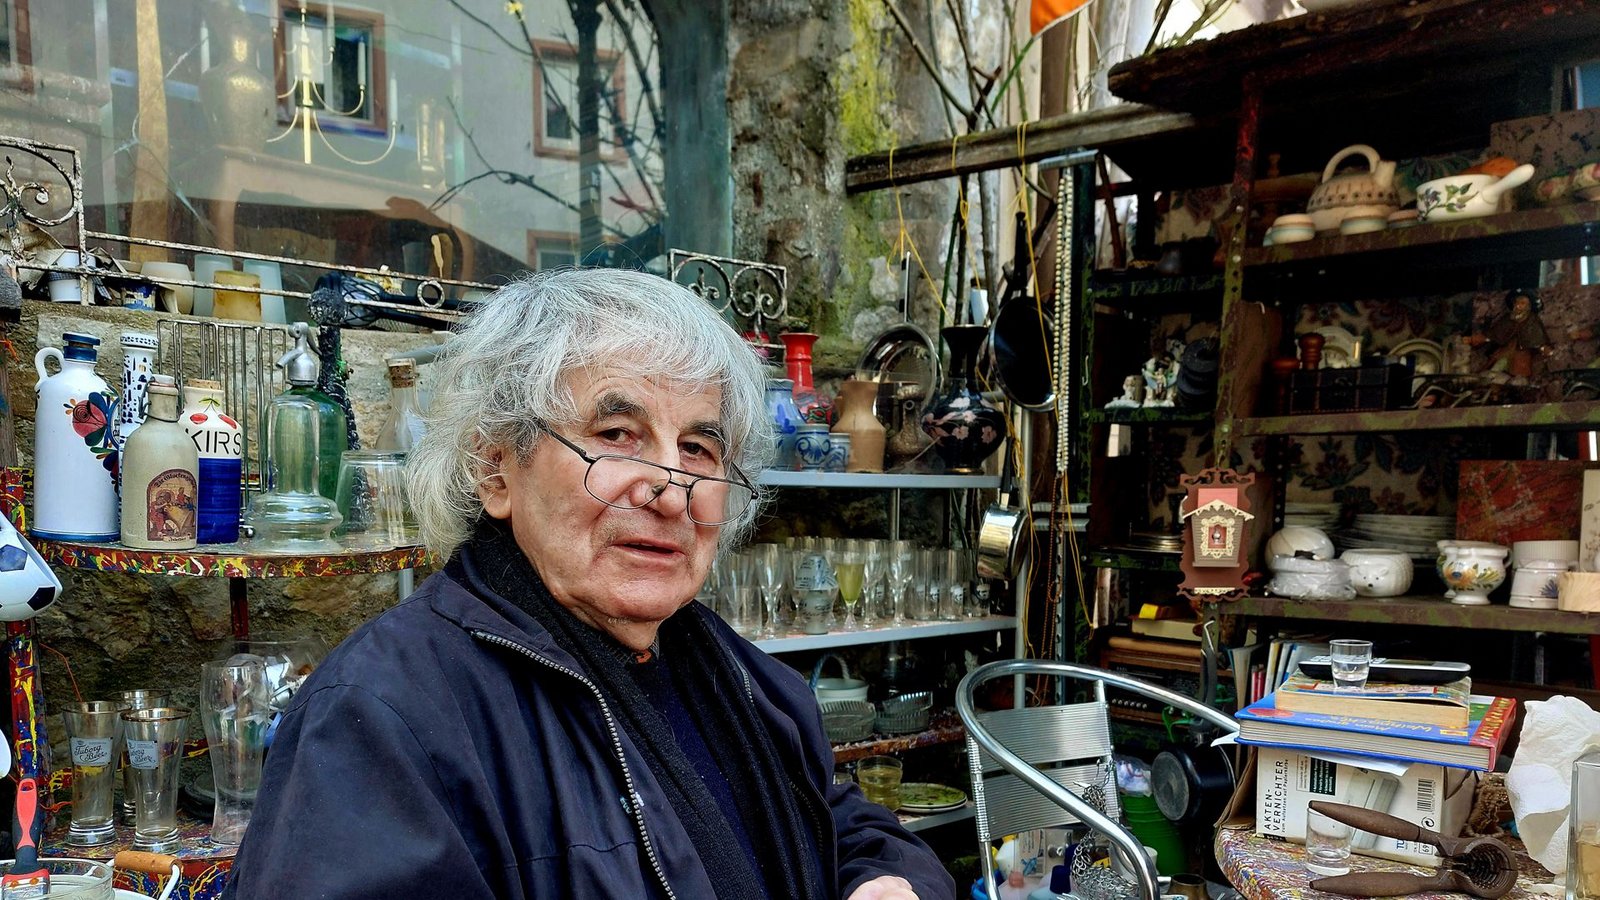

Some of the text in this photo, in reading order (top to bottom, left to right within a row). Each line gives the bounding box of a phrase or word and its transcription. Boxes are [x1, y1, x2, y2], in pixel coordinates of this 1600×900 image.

[74, 744, 102, 757] Tuborg
[1264, 789, 1273, 831] AKTEN-
[1273, 760, 1284, 831] VERNICHTER
